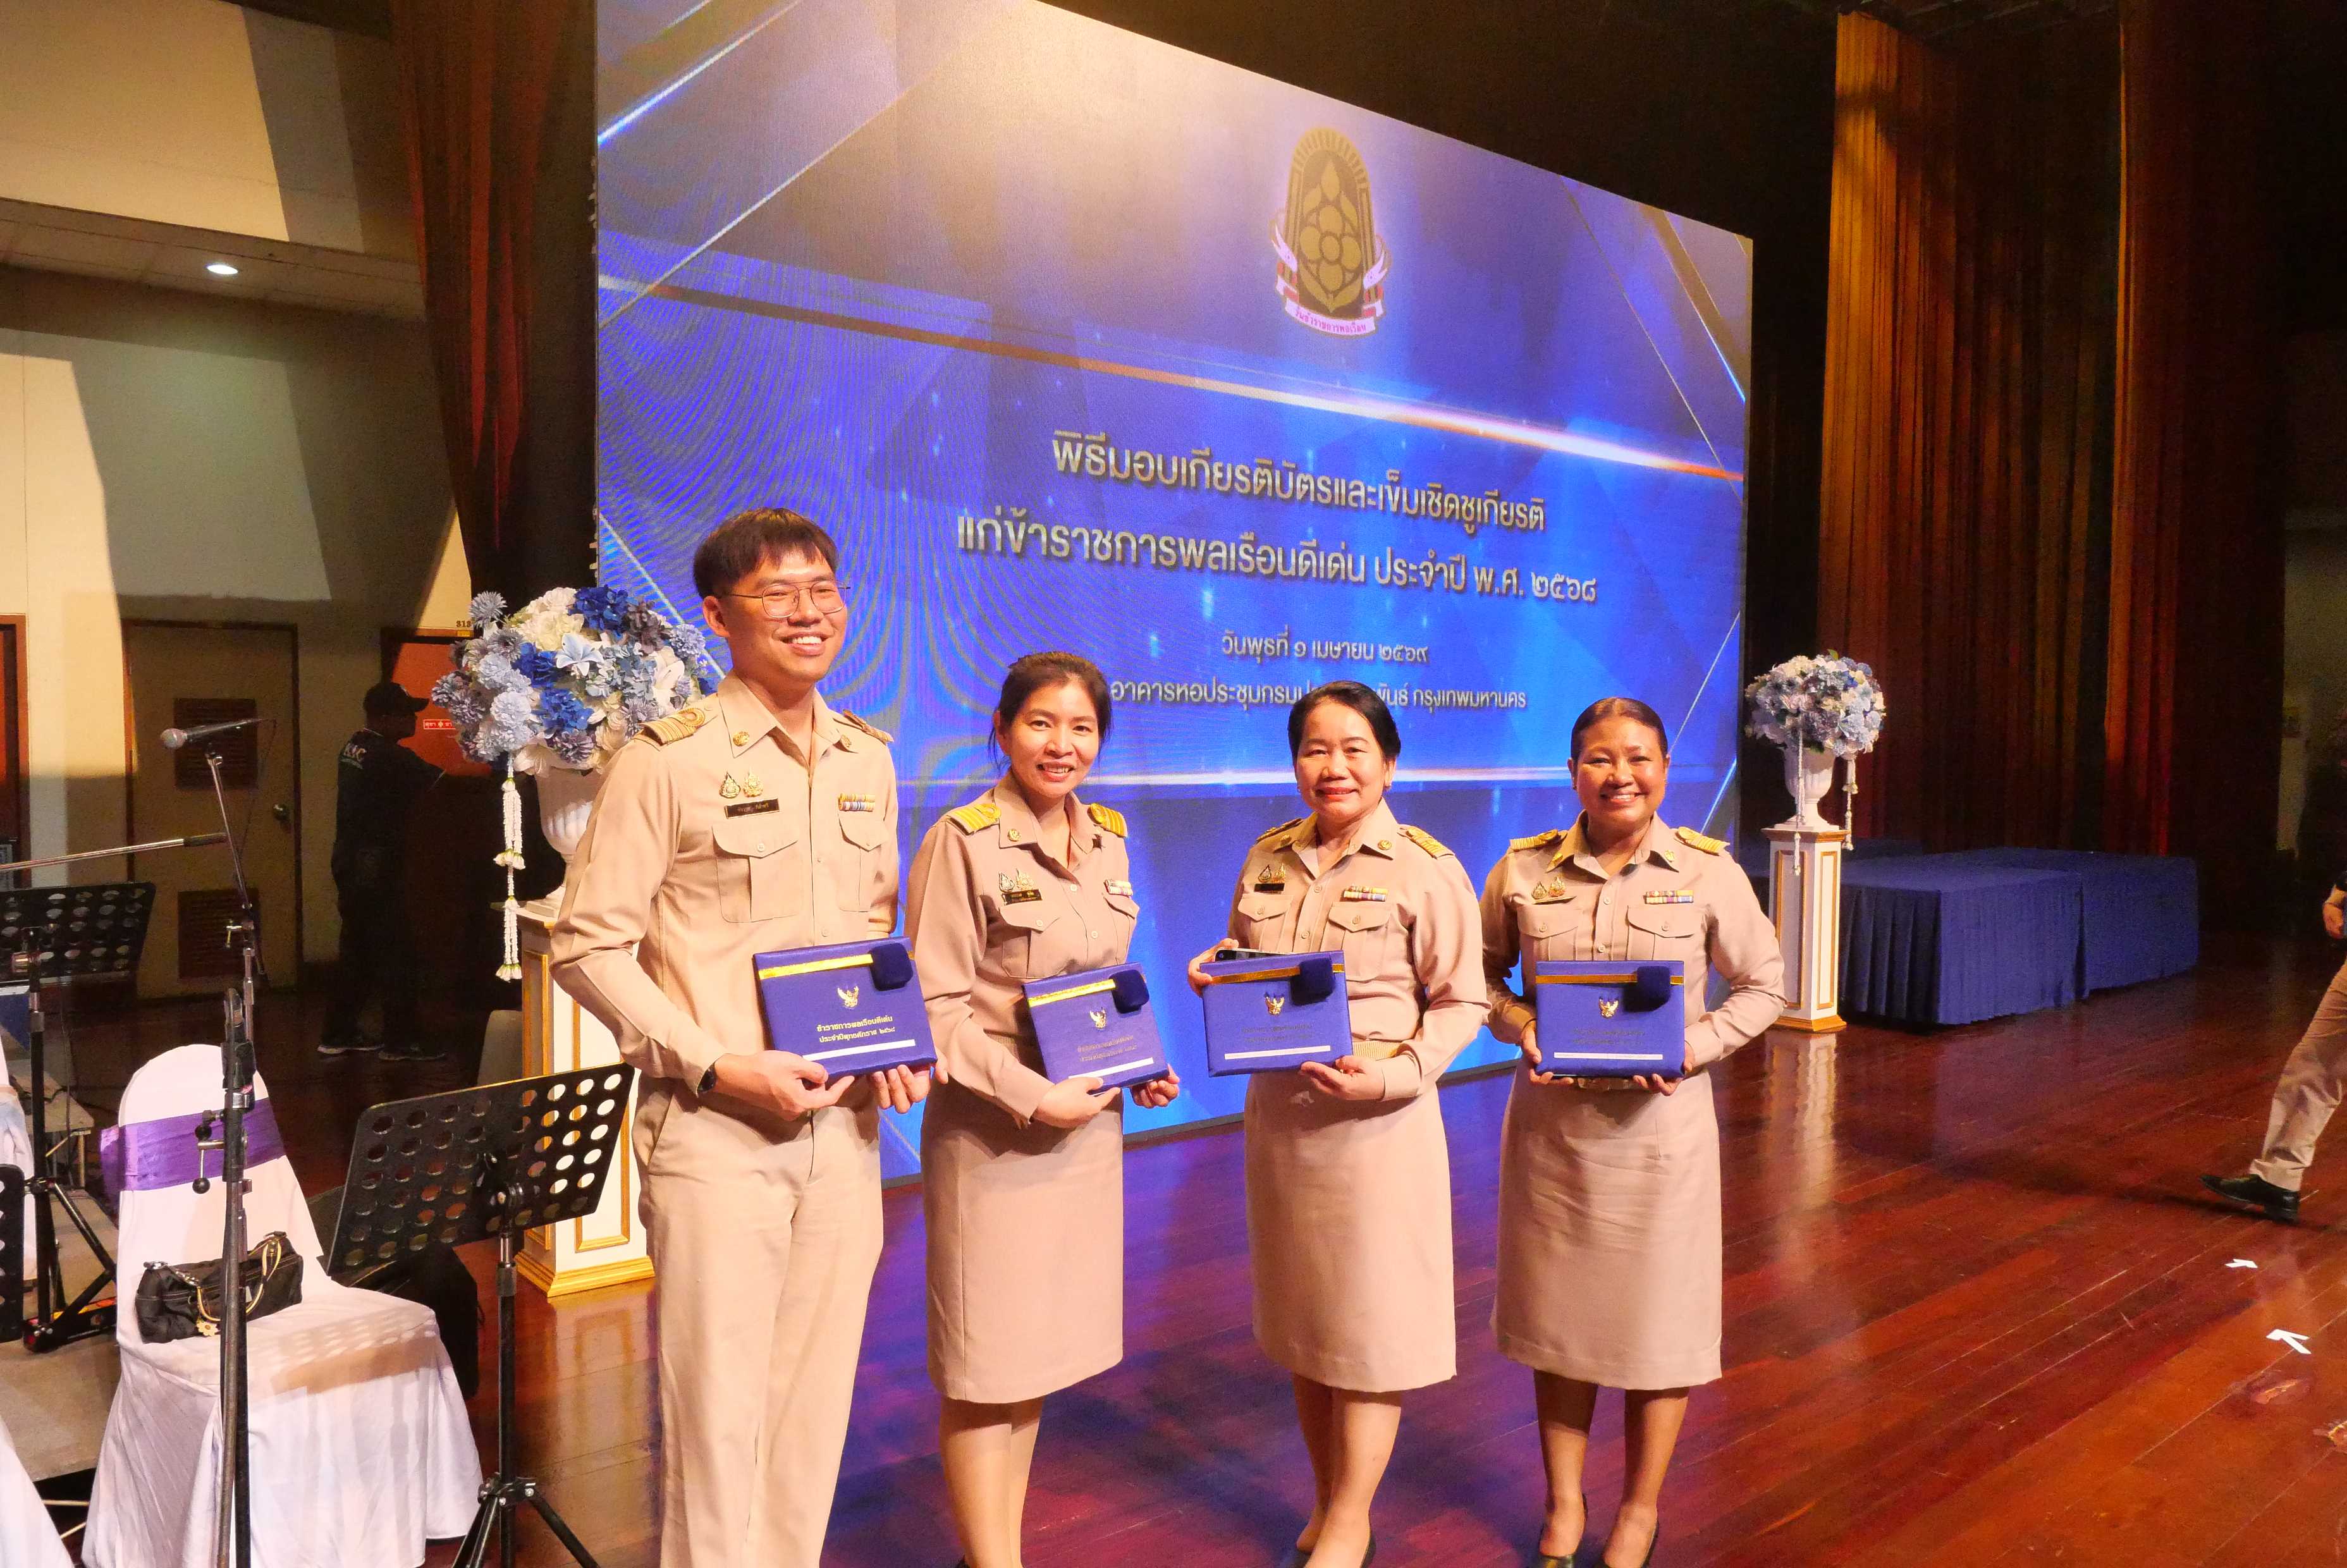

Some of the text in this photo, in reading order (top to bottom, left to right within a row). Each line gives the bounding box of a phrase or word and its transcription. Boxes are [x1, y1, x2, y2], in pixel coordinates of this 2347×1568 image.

[1052, 429, 1545, 534] พิธีมอบเกียรติบัตรและเข็มเชิดชูเกียรติ
[957, 505, 1596, 601] แก่ข้าราชการพลเรือนดีเด่น ประจำปี พ.ศ. ๒๕๖๘
[1222, 624, 1289, 664] วันพุธที่
[1312, 640, 1375, 661] เมษายน
[1378, 644, 1429, 663] ๒๕๖๙
[1413, 688, 1527, 713] กรุงเทพมหานคร
[816, 1015, 893, 1032] ข้าราชการพลเรือนดีเด่น
